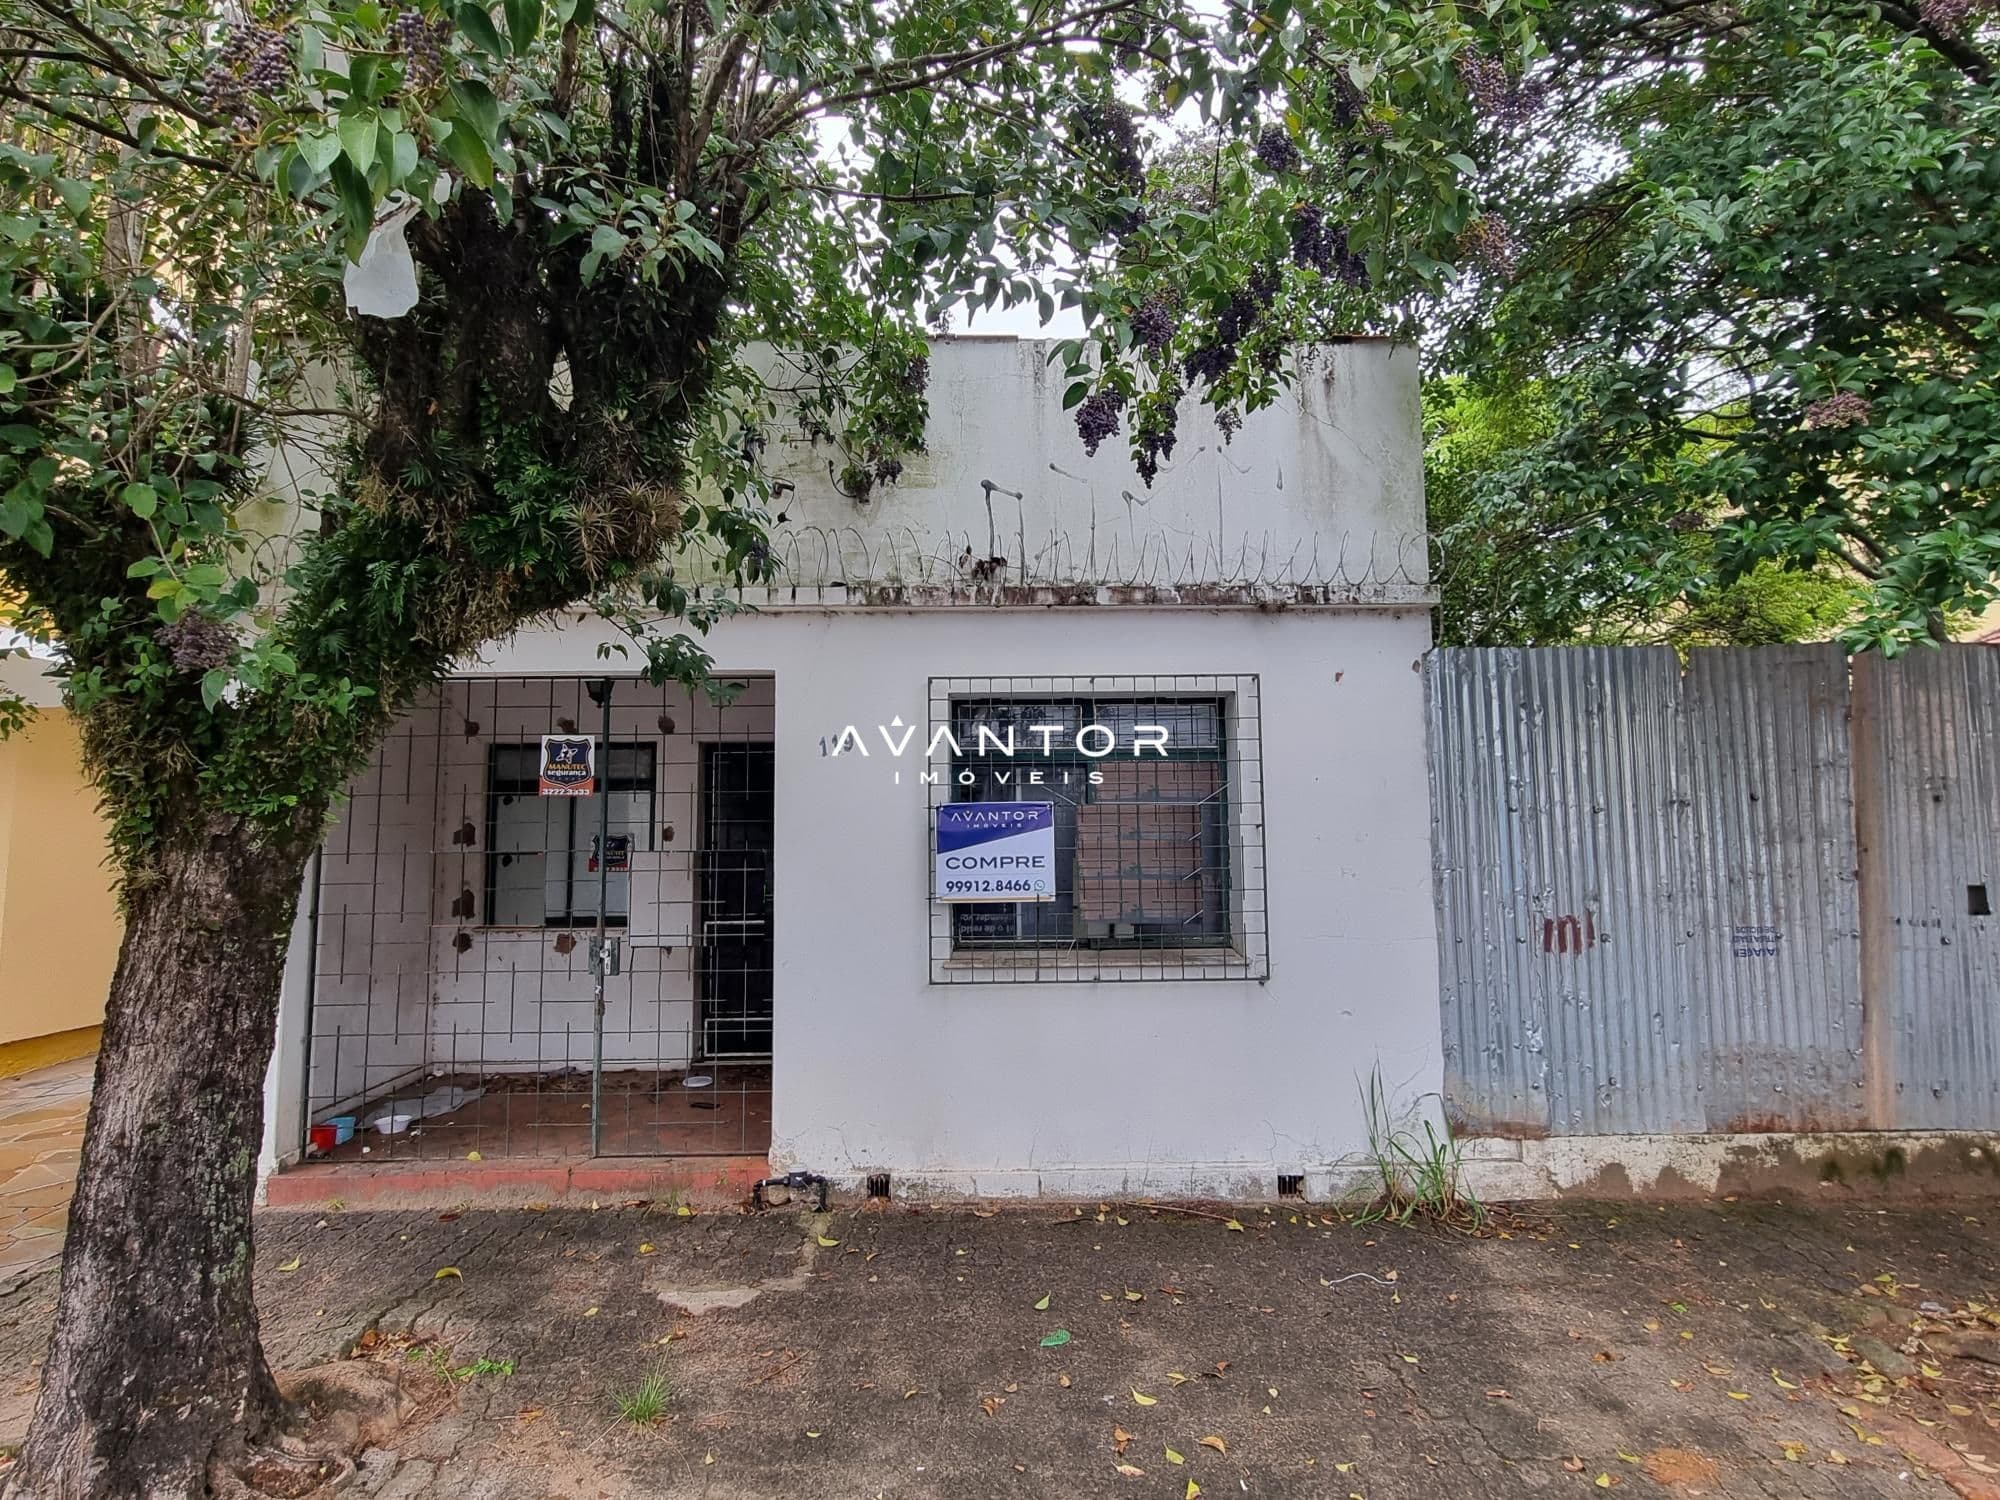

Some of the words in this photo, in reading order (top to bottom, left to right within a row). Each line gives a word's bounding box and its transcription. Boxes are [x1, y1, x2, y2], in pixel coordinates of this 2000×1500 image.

[547, 769, 587, 777] segurança
[951, 811, 1039, 822] AVANTOR
[945, 855, 1046, 870] COMPRE
[946, 879, 1031, 892] 99912.8466
